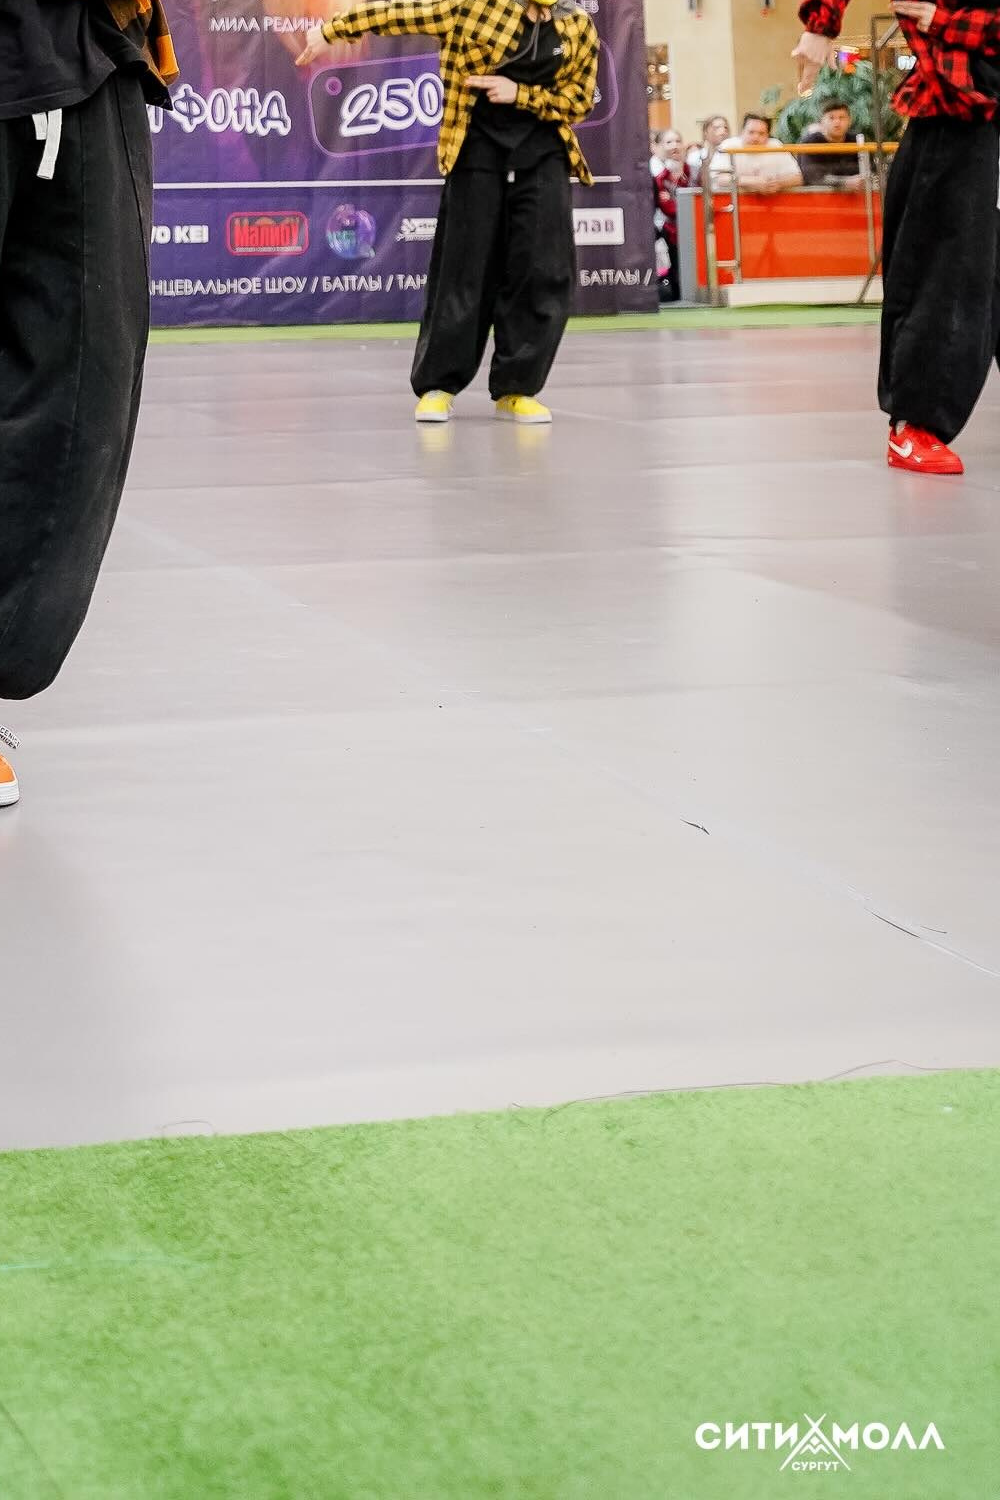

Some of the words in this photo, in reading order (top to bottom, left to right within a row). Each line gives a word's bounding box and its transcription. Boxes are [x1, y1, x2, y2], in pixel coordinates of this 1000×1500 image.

[210, 16, 261, 33] МИЛА
[264, 275, 308, 294] ШОУ
[321, 274, 382, 293] БАТТЛЫ
[579, 268, 641, 287] БАТТЛЫ
